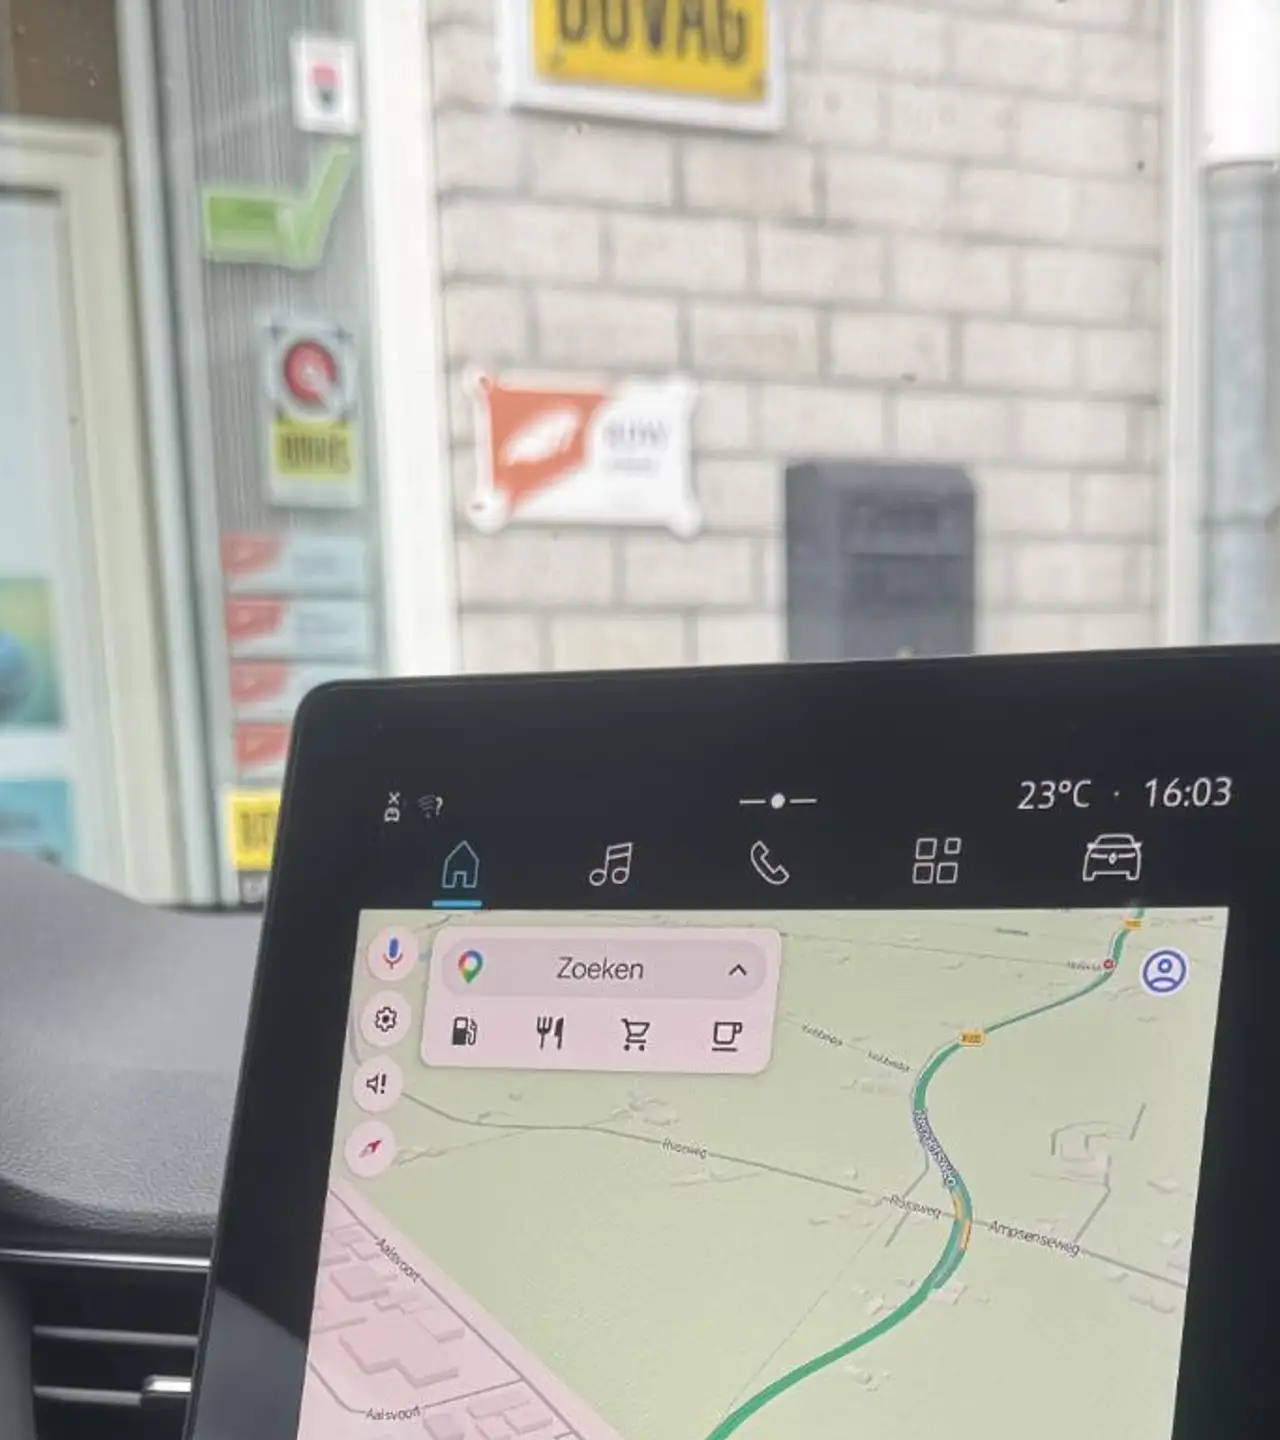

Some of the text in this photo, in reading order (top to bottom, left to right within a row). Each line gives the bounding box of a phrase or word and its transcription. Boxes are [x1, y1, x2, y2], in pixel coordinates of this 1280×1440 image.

[1017, 776, 1233, 811] 23°C 16:03
[556, 956, 645, 981] Zoeken
